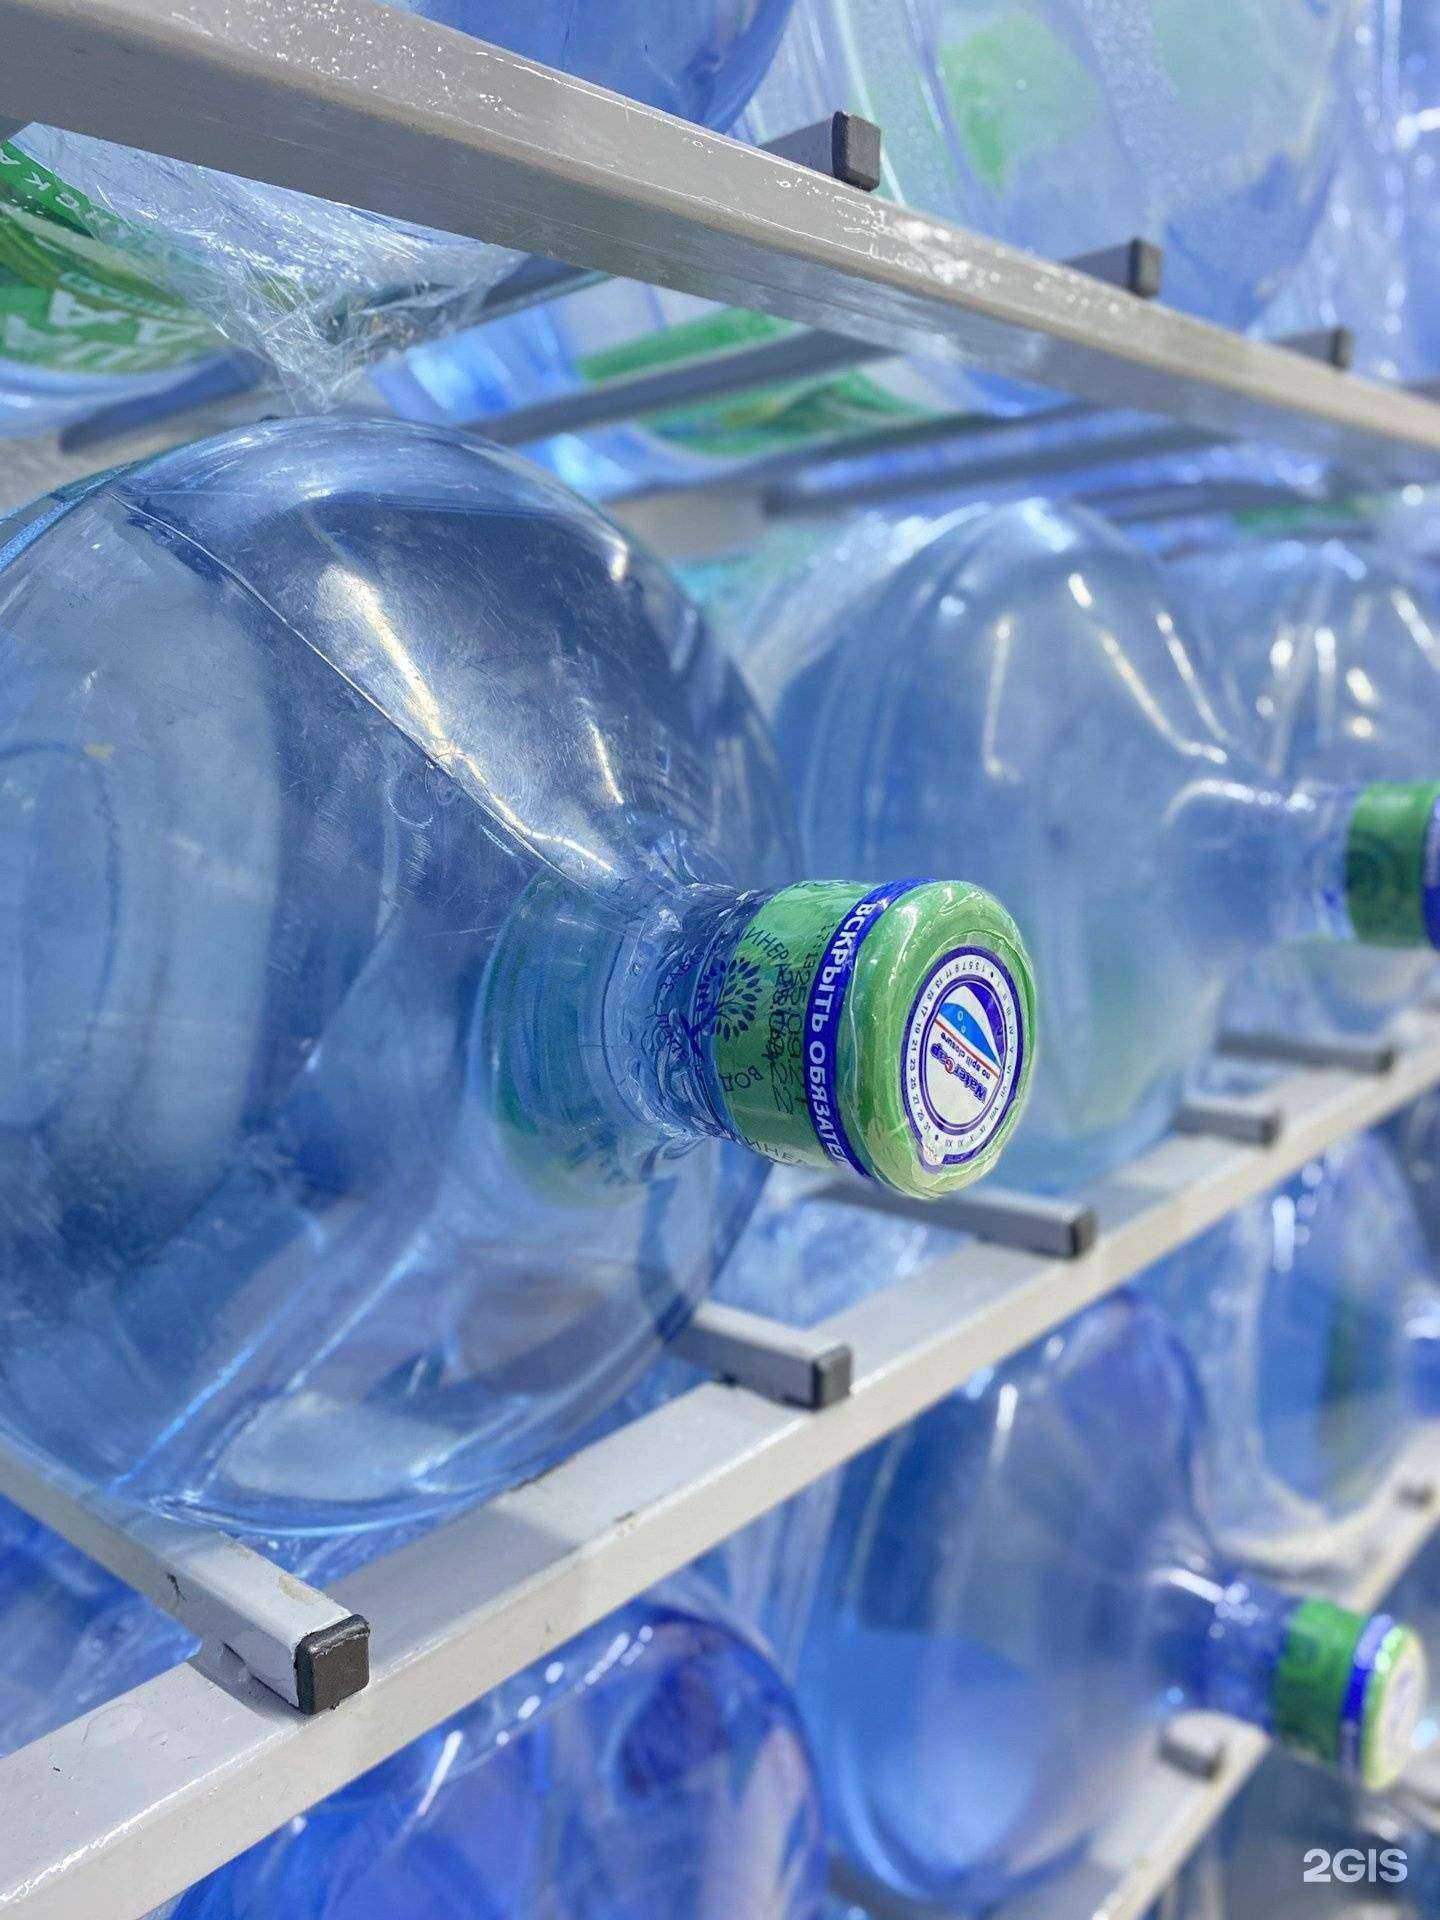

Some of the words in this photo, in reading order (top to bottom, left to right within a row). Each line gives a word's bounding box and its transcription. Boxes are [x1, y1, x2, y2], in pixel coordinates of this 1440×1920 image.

[811, 902, 873, 1033] ВСКРЫТЬ
[940, 1031, 966, 1058] closure
[965, 1055, 981, 1072] spill
[981, 1069, 991, 1080] no
